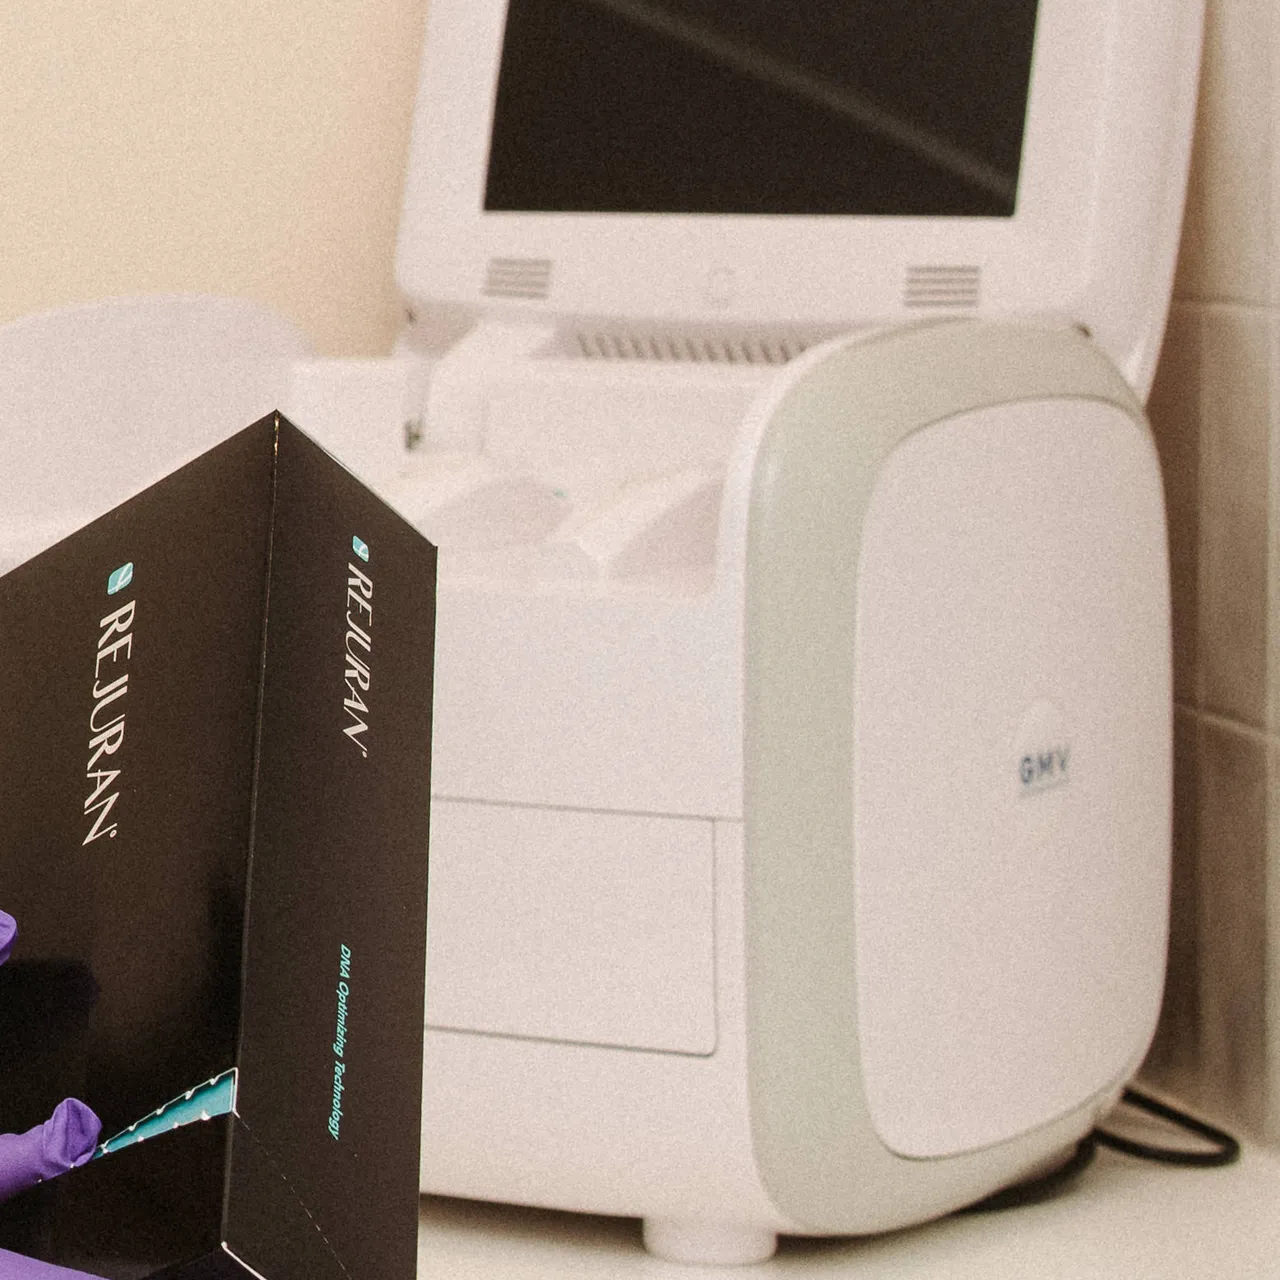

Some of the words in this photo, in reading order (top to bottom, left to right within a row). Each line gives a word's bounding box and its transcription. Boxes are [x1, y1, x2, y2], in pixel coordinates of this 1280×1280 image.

[342, 562, 374, 758] REJURAN
[82, 600, 137, 846] REJURAN
[339, 943, 352, 979] DNA
[332, 981, 350, 1058] Optimizing
[327, 1060, 346, 1141] Technology
